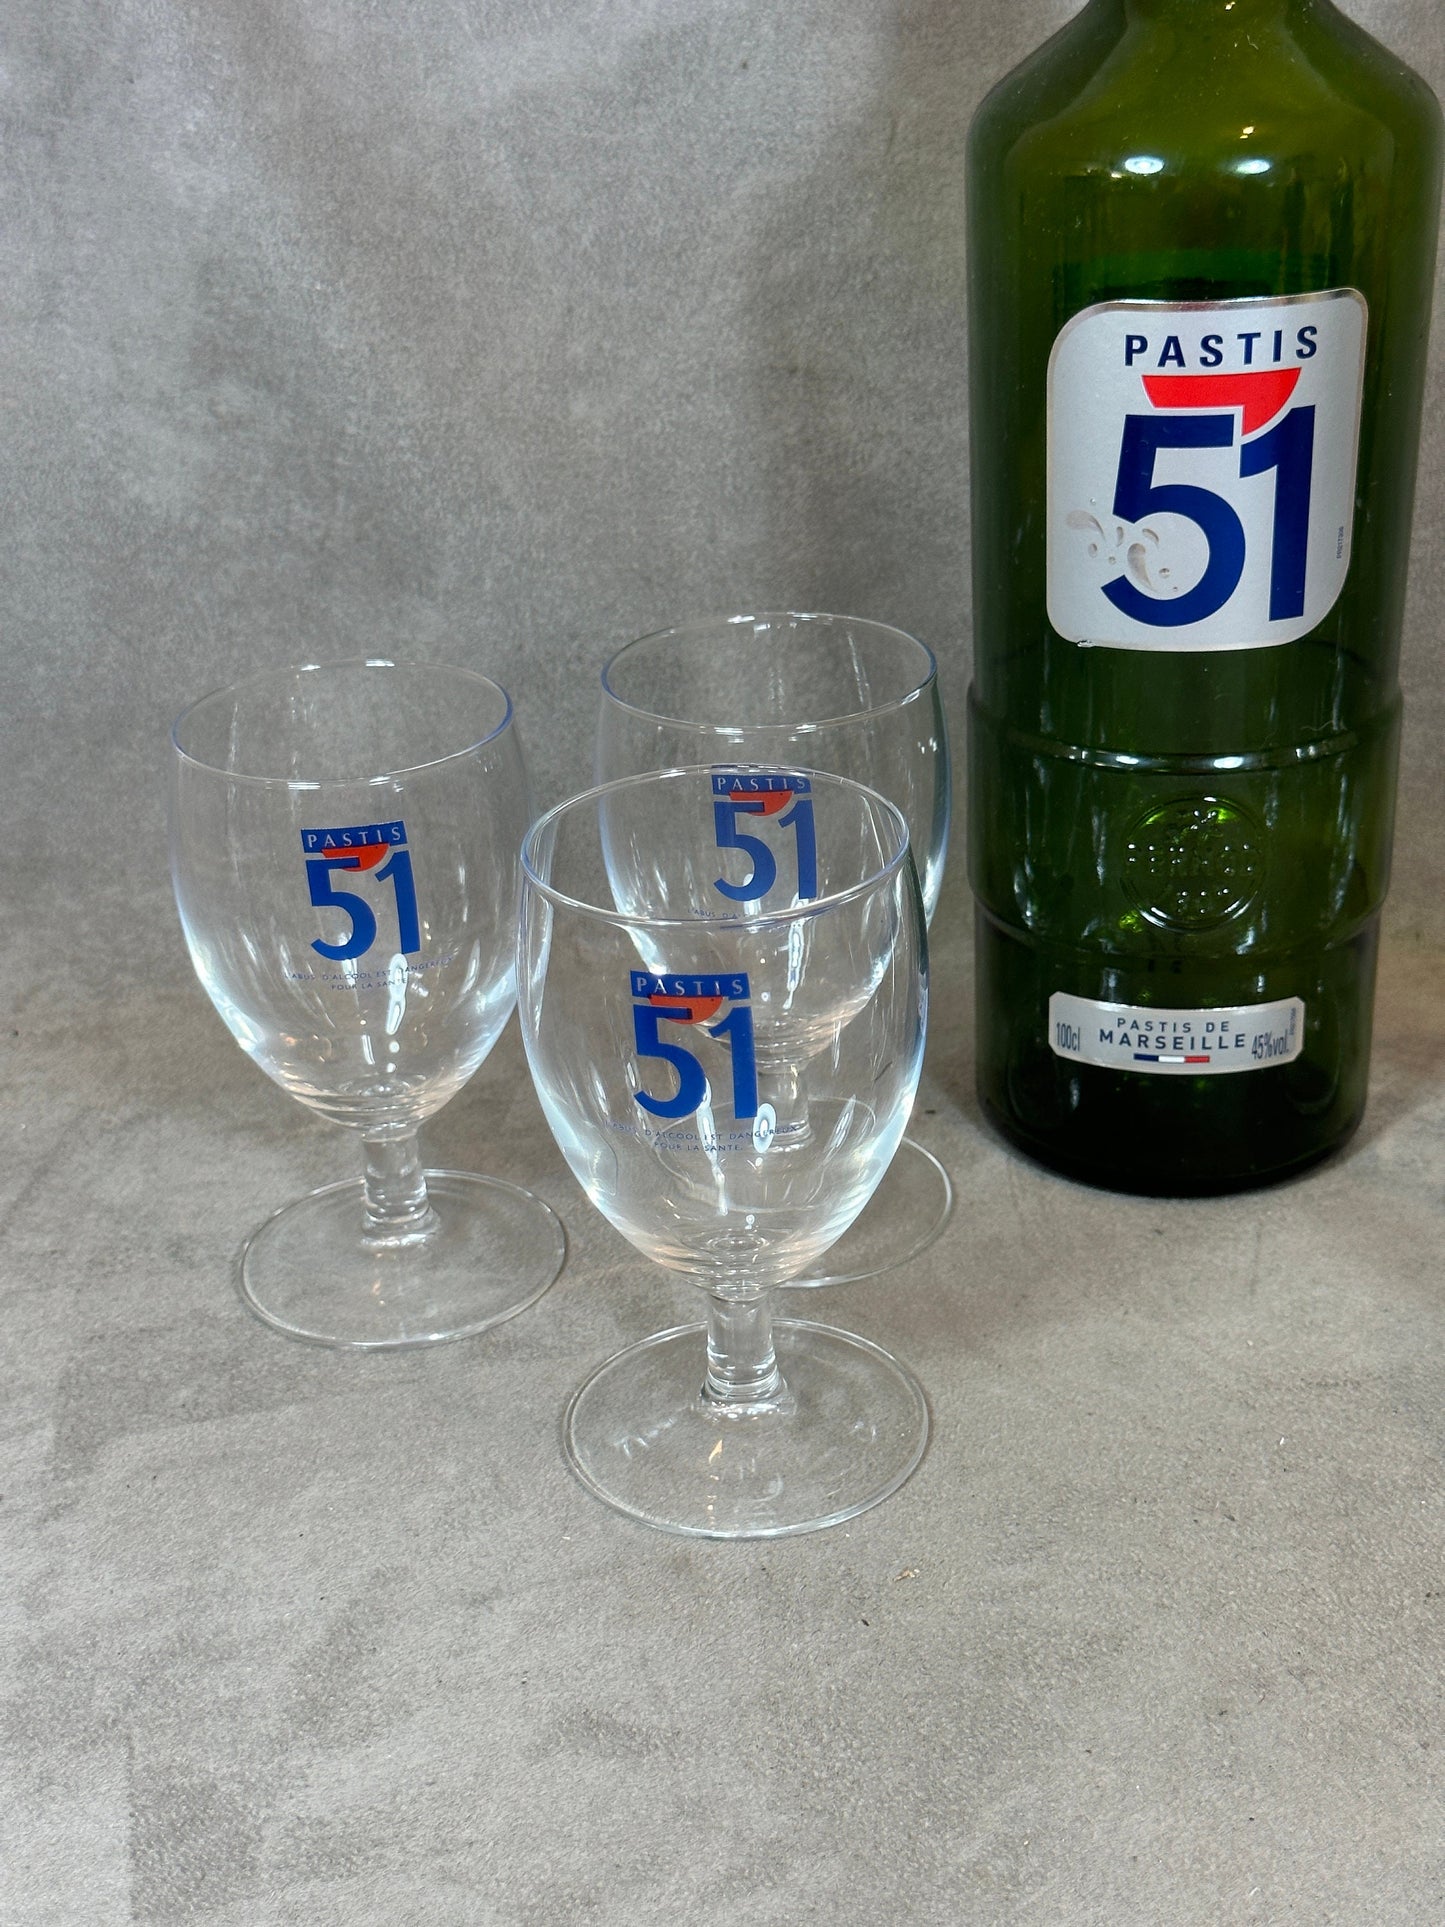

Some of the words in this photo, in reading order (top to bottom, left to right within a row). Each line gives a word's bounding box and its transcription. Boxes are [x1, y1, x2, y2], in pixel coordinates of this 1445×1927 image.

[1124, 325, 1318, 367] PASTIS
[1100, 404, 1316, 628] 51
[717, 777, 806, 791] PASTIS
[307, 826, 402, 848] PASTIS
[713, 799, 818, 903] 51
[305, 850, 422, 962] 51
[636, 977, 745, 996] PASTIS
[1056, 1021, 1081, 1052] 100cl
[1099, 1029, 1246, 1051] MARSEILLE
[1116, 1017, 1192, 1034] PASTIS
[1205, 1020, 1230, 1033] DE
[632, 1004, 759, 1120] 51
